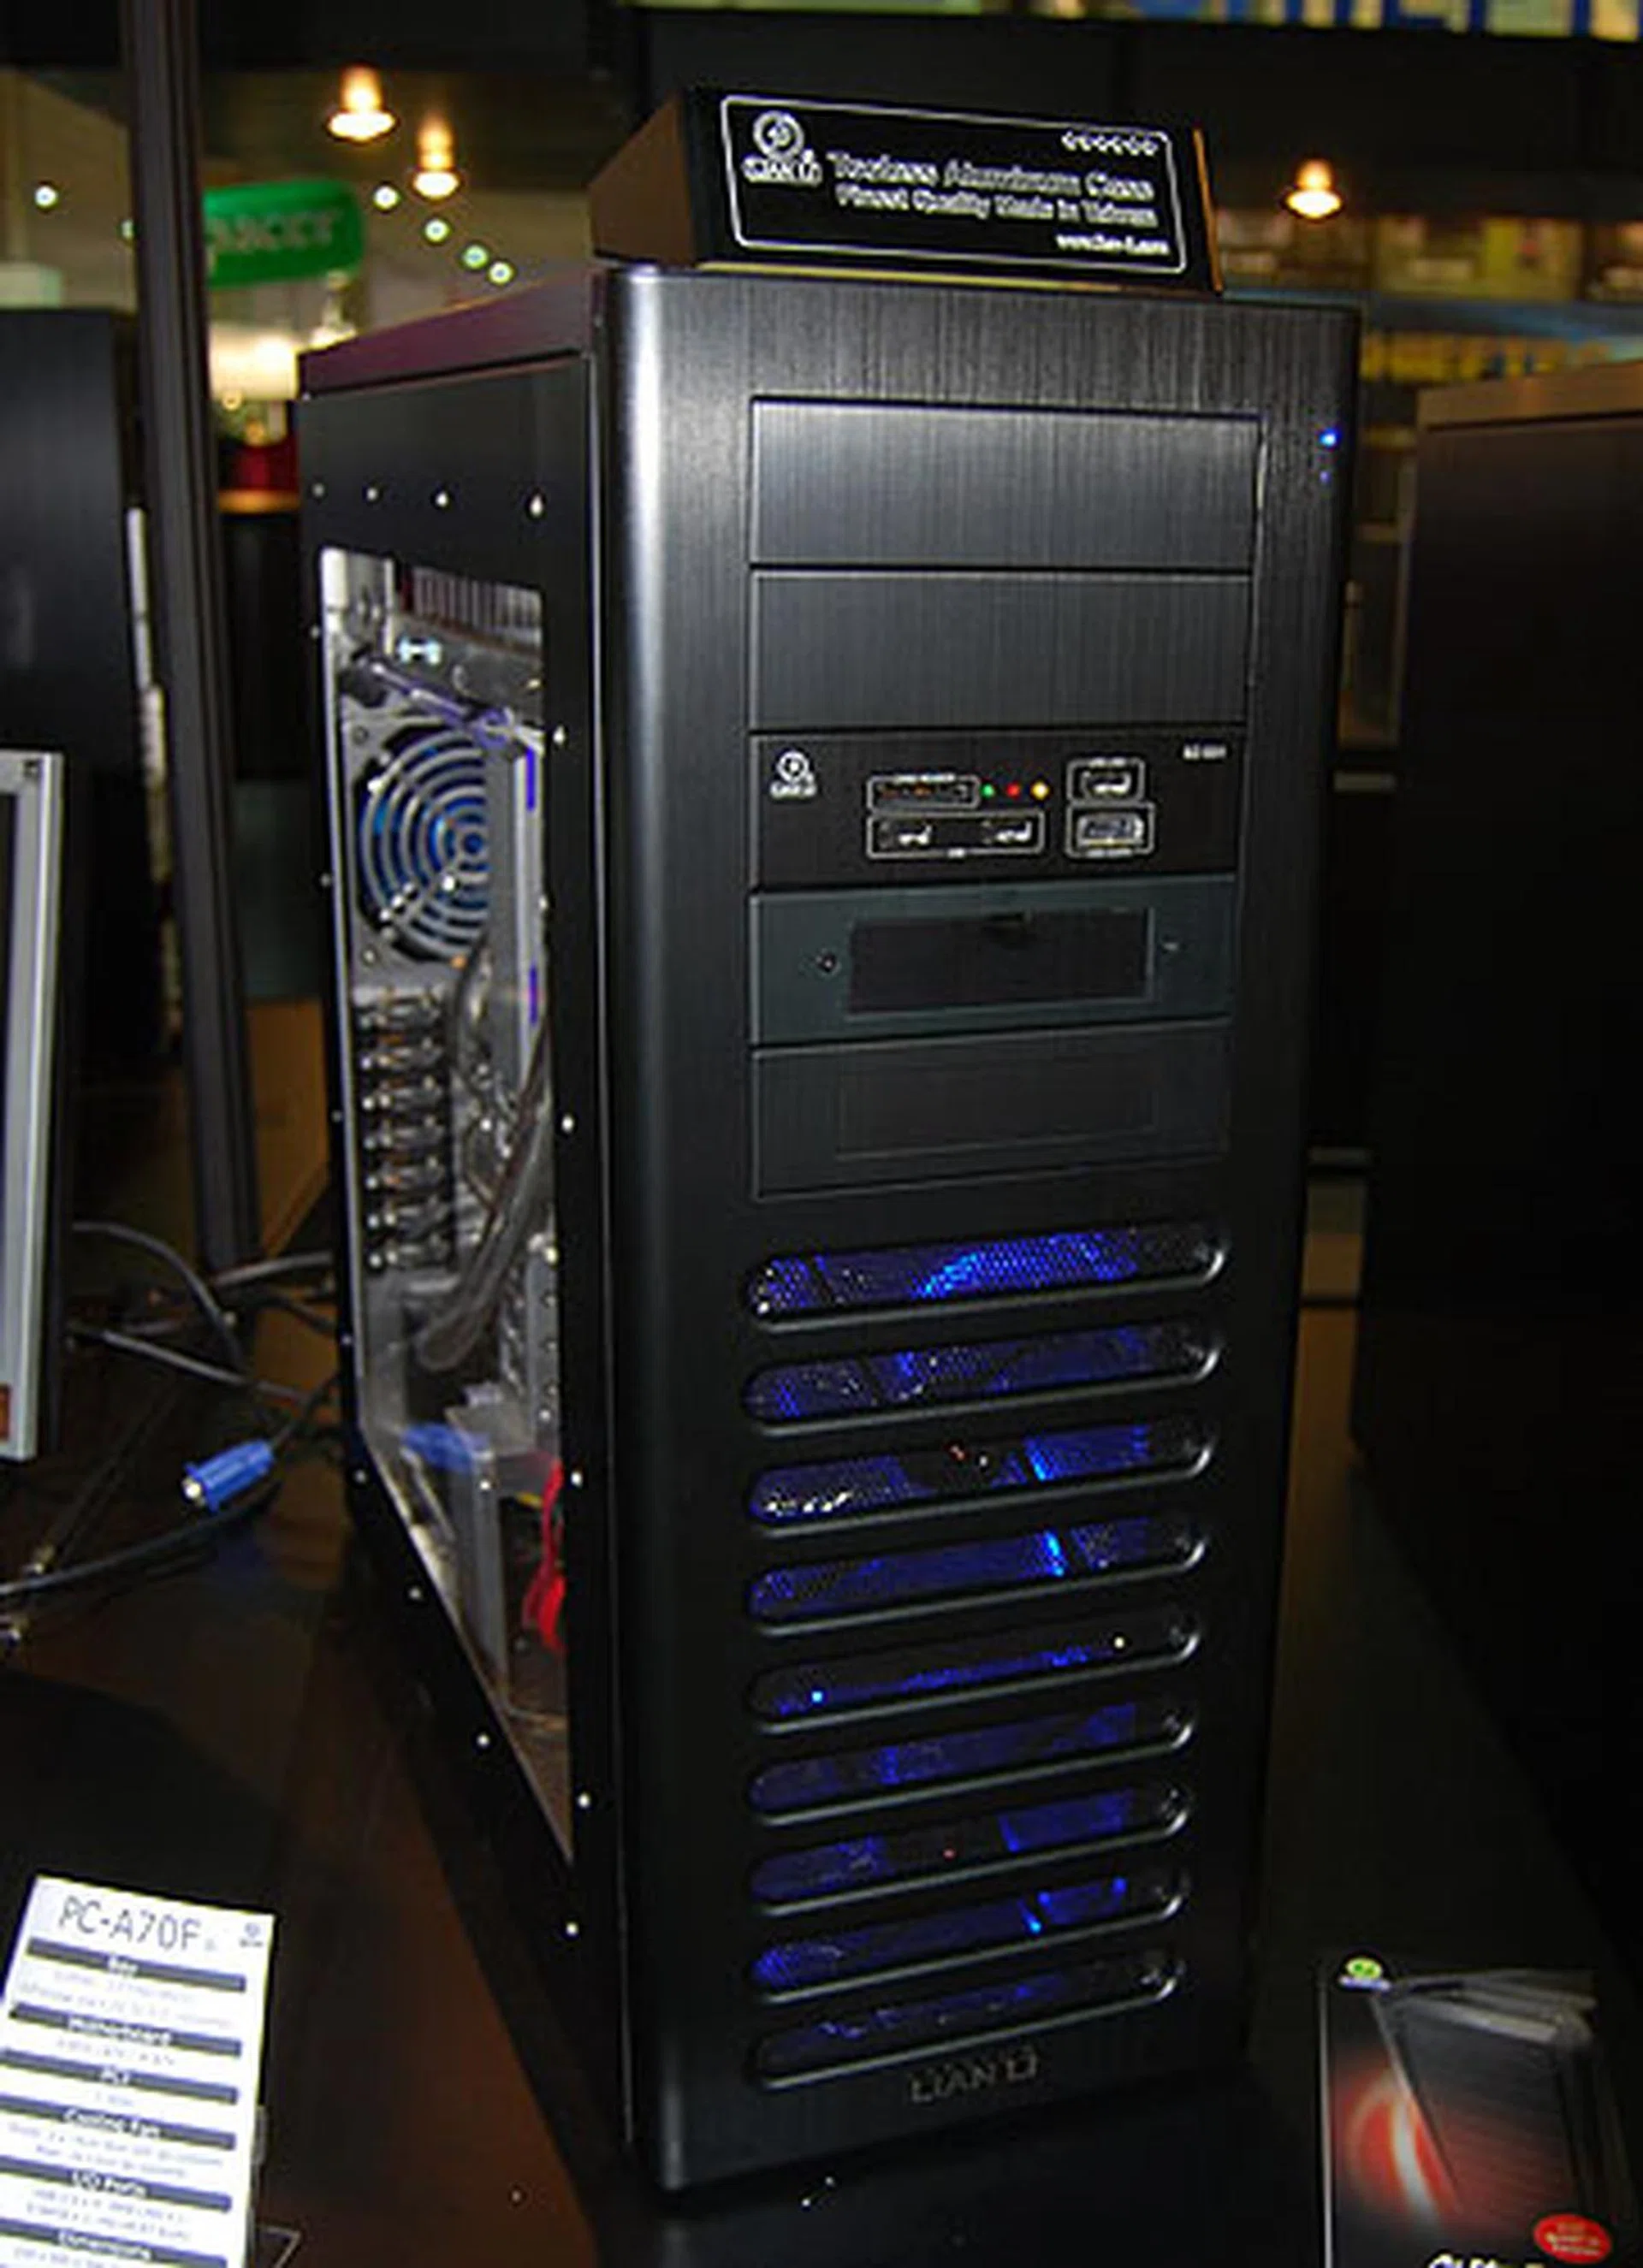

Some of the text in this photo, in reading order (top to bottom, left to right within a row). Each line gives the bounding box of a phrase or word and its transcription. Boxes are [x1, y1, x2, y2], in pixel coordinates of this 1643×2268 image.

[1085, 170, 1156, 201] Class
[912, 188, 991, 220] Quality
[58, 1894, 202, 1951] PC-A70F
